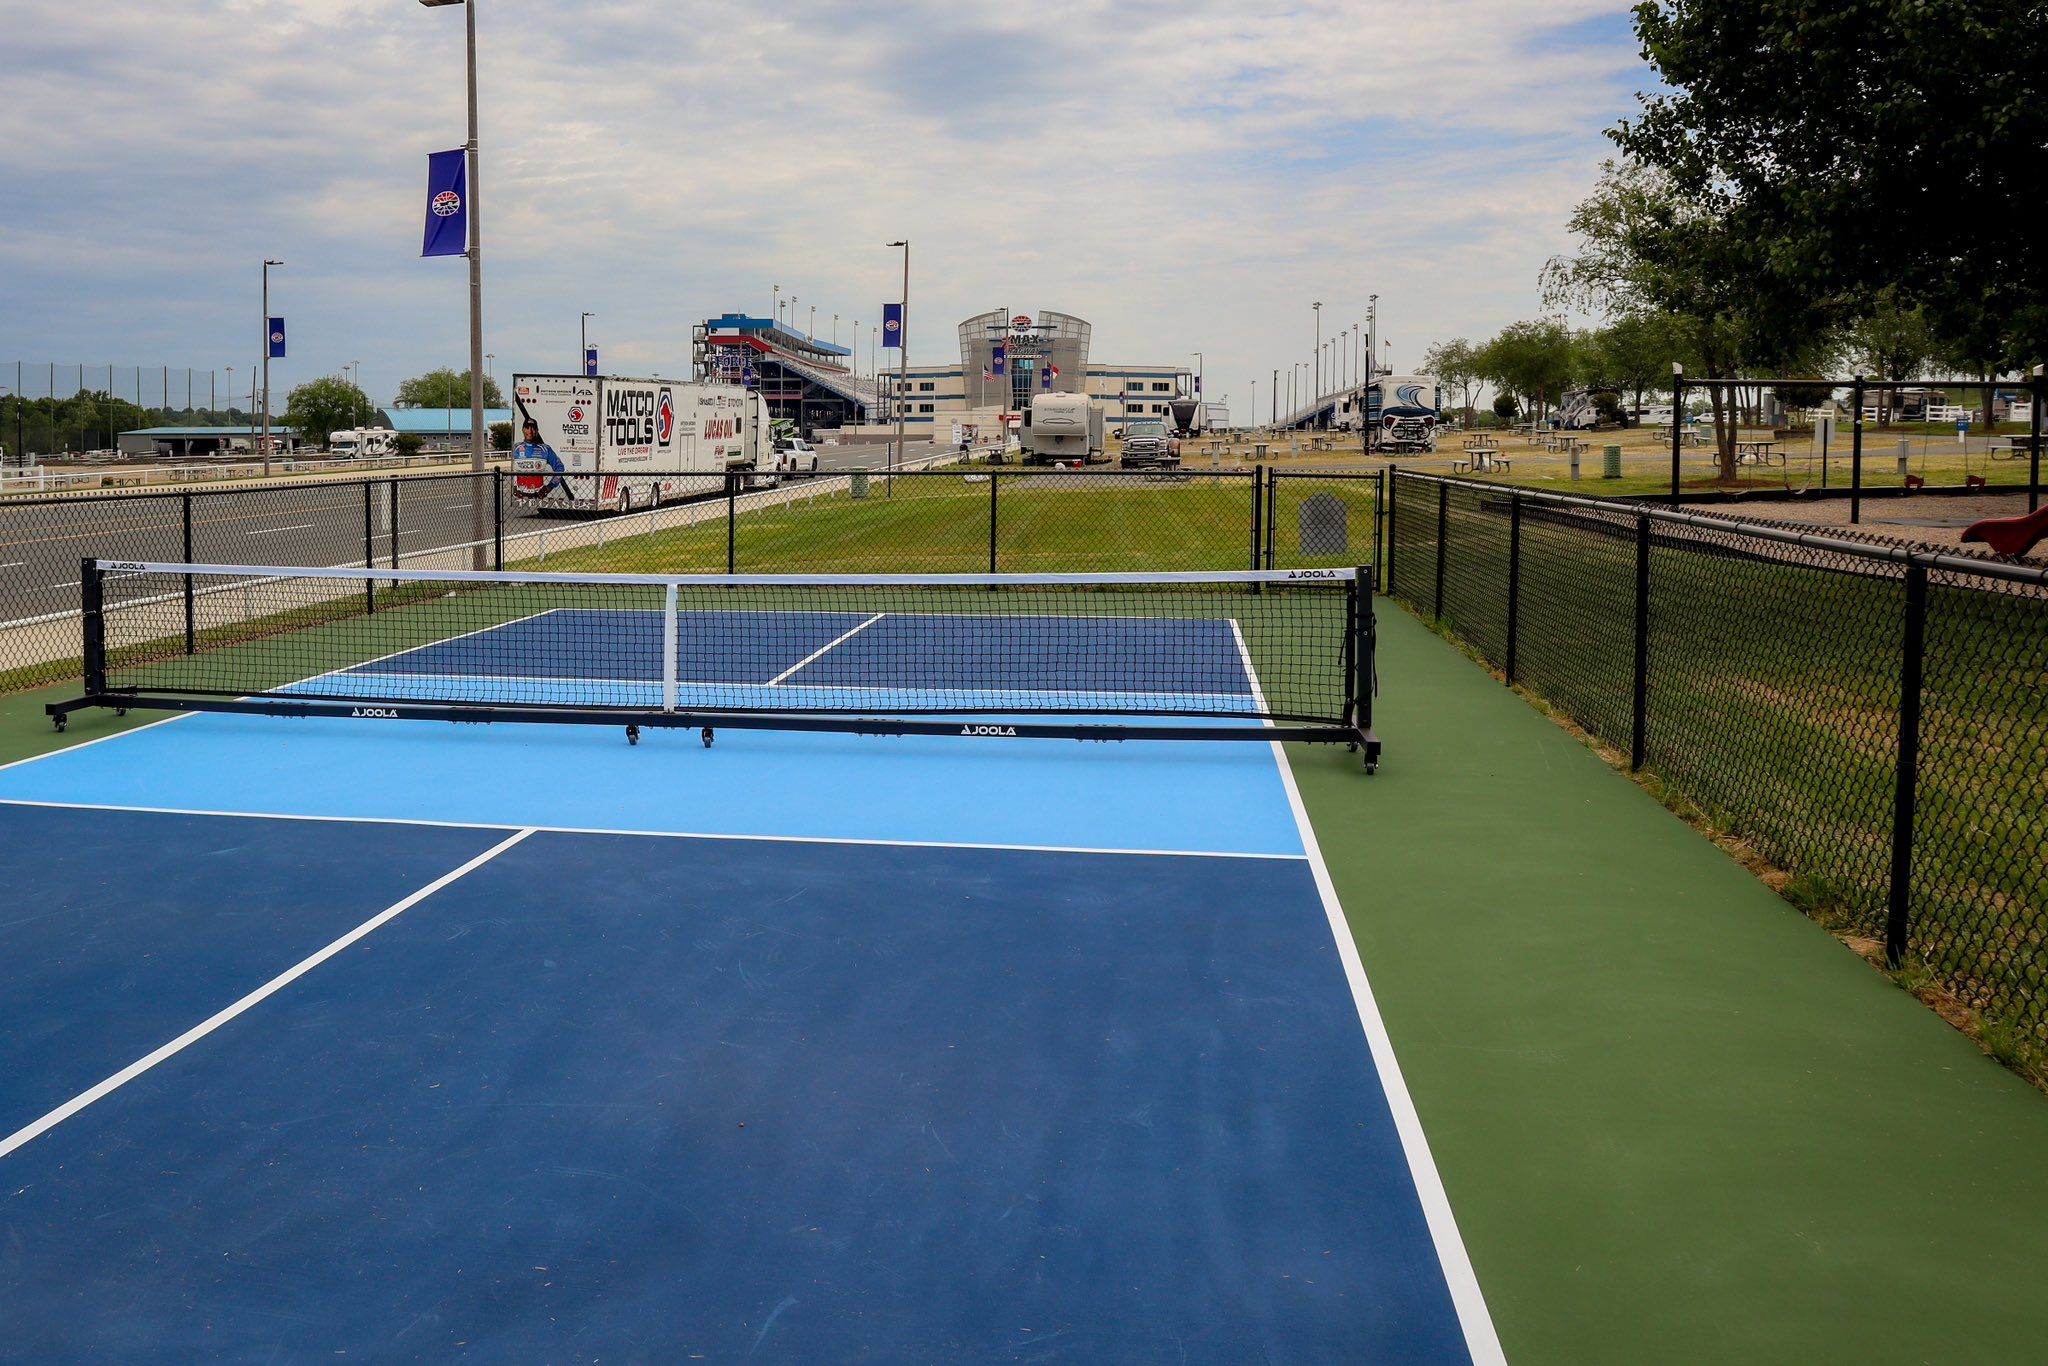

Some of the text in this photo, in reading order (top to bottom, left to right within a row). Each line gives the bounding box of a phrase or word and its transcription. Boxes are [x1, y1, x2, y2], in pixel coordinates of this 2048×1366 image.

[607, 389, 654, 417] MATCO
[607, 418, 653, 446] TOOLS
[704, 419, 733, 440] LUCAS OIL
[1298, 570, 1336, 578] JOOLA
[360, 708, 398, 718] JOOLA
[971, 725, 1017, 736] JOOLA
